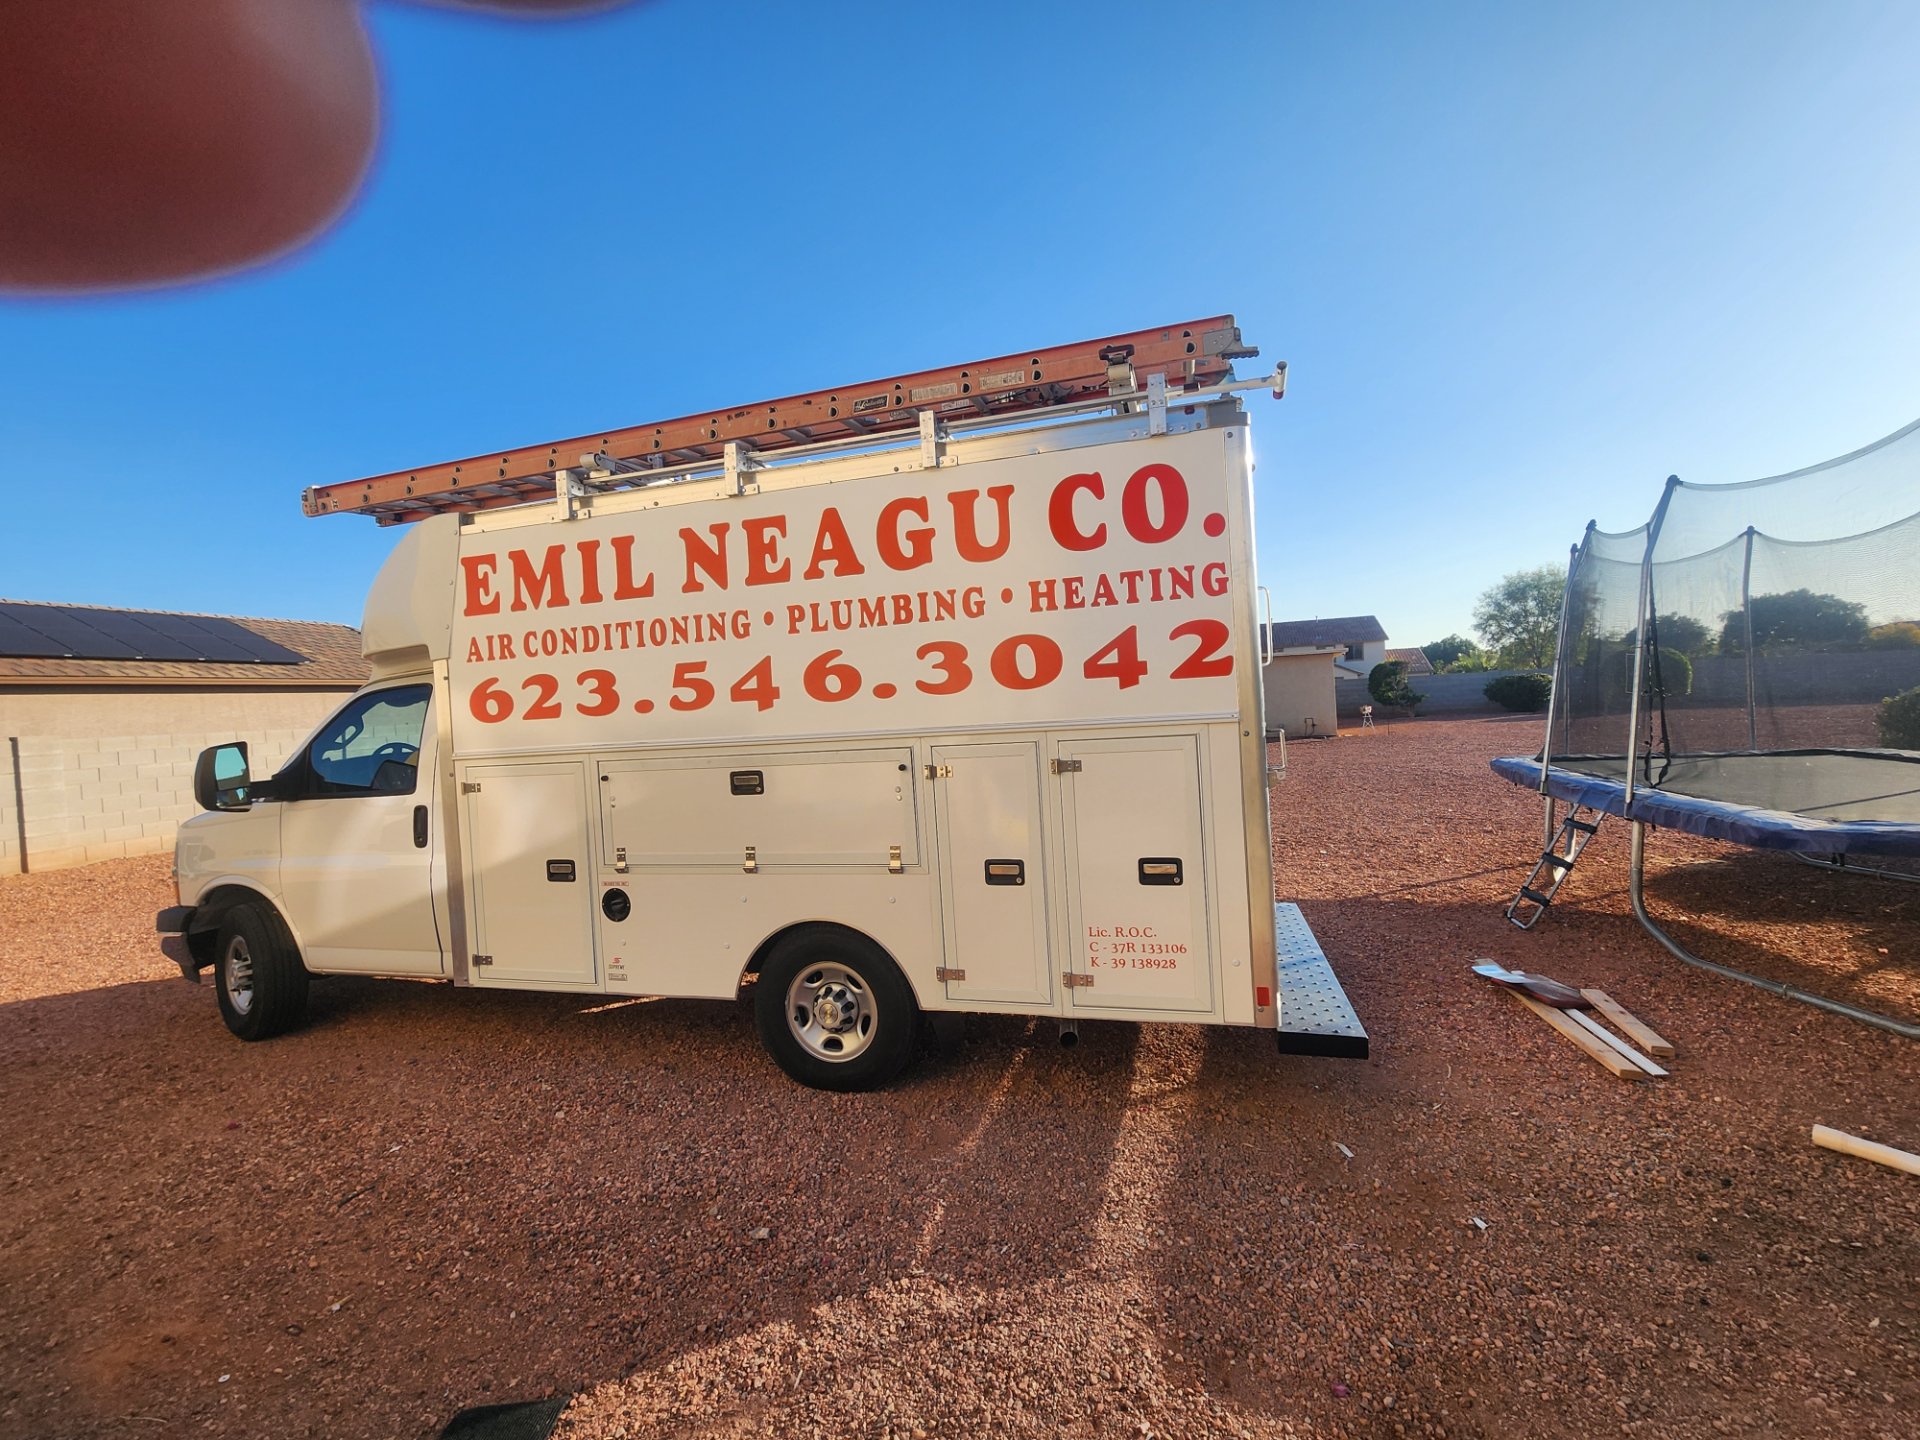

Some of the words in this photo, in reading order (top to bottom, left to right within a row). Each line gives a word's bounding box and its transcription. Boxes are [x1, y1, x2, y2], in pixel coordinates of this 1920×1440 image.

[460, 534, 655, 618] EMIL
[679, 483, 1015, 594] NEAGU
[1047, 462, 1226, 552] CO.
[466, 632, 517, 664] AIR
[522, 608, 752, 660] CONDITIONING
[786, 586, 986, 636] PLUMBING
[1027, 561, 1230, 613] HEATING
[469, 618, 1235, 725] 623.546.3042
[1088, 927, 1111, 938] Lic.
[1115, 927, 1157, 938] R.O.C.
[1089, 941, 1099, 953] C
[1111, 942, 1137, 954] 37R
[1141, 944, 1187, 954] 133106
[1090, 956, 1101, 968] K
[1111, 957, 1126, 969] 39
[1132, 959, 1177, 969] 138928
